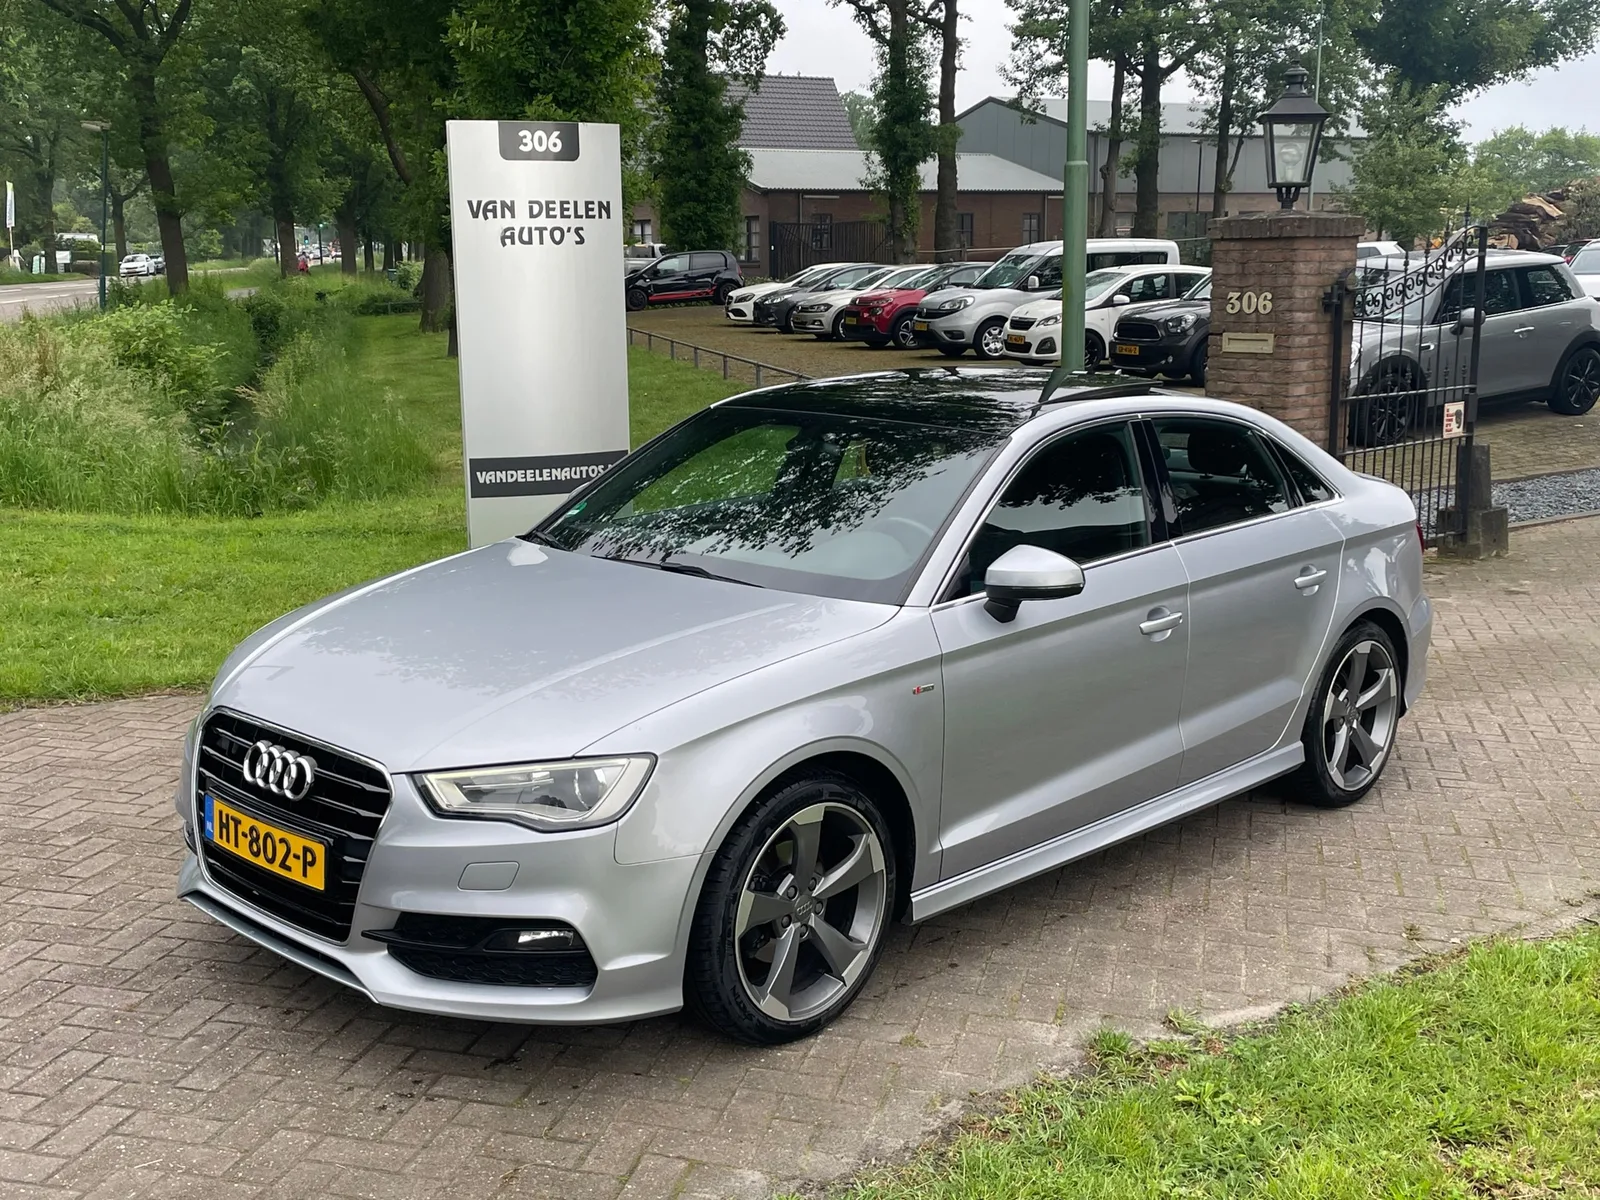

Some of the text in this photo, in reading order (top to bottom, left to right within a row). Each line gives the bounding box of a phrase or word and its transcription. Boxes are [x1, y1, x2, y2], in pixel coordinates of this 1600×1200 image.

[518, 130, 563, 153] 306
[467, 200, 611, 221] VAN DEELEN
[500, 226, 585, 247] AUTO'S
[1226, 291, 1273, 314] 306
[476, 463, 612, 485] VANDEELENAUTOS
[219, 809, 316, 878] HT-802-P
